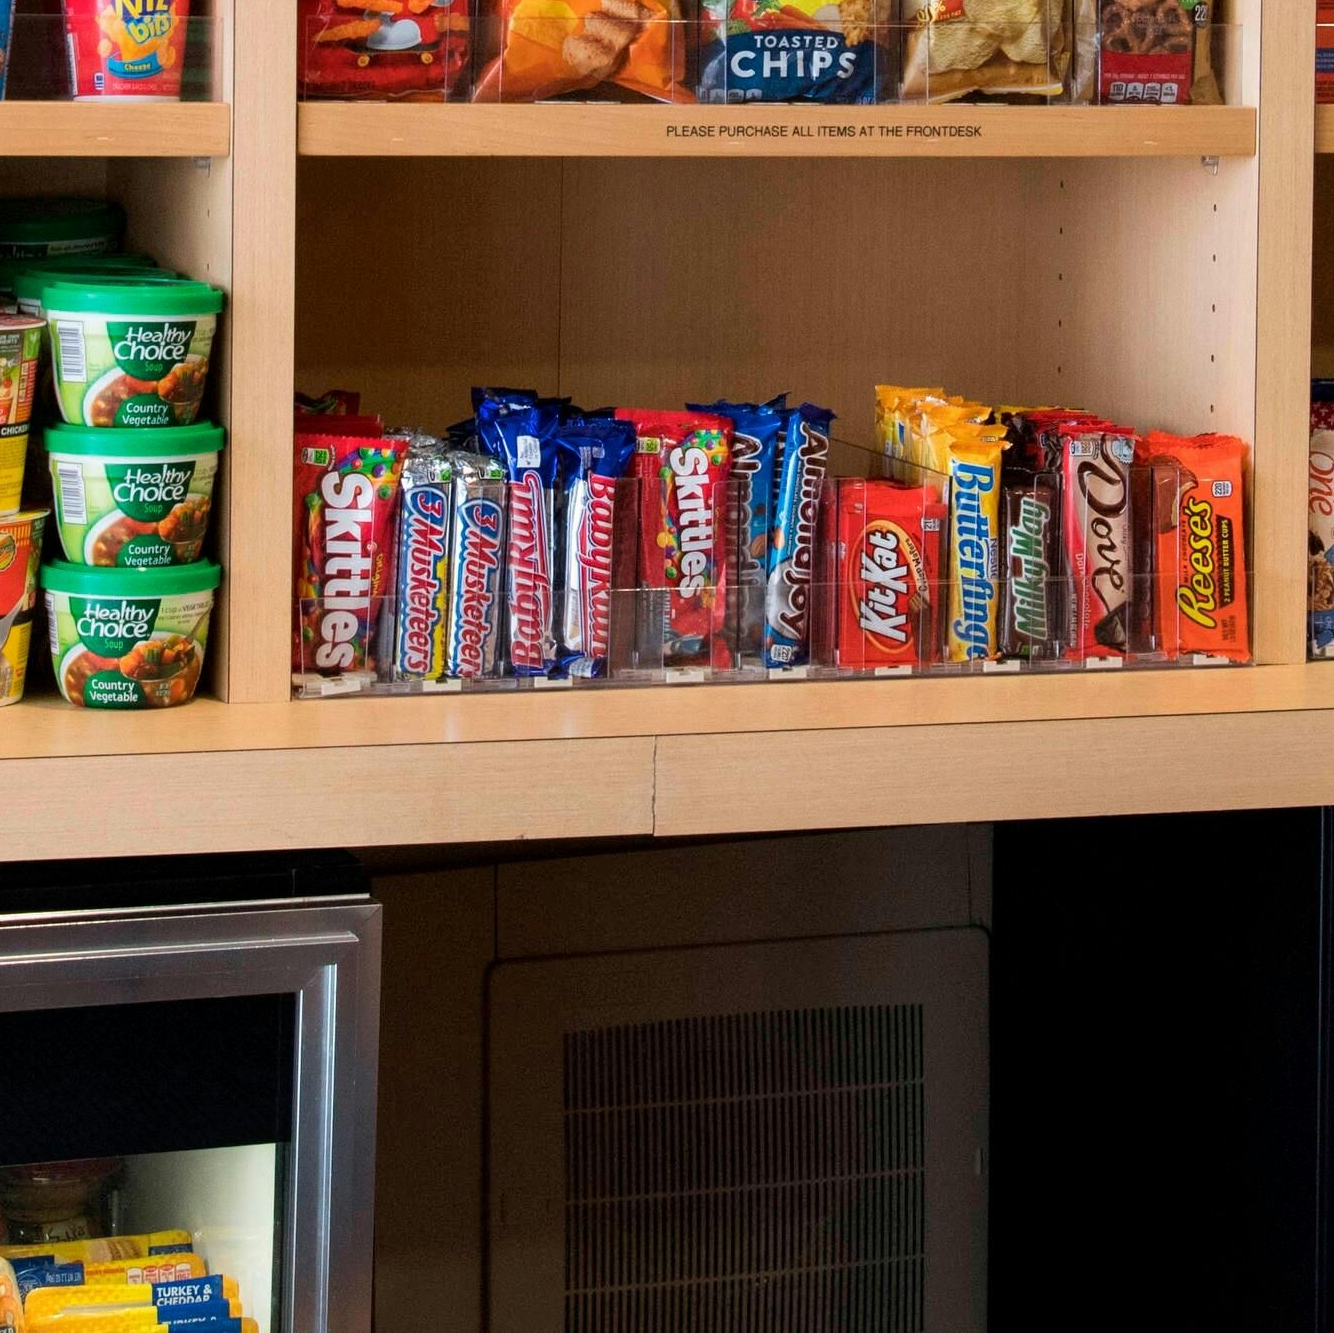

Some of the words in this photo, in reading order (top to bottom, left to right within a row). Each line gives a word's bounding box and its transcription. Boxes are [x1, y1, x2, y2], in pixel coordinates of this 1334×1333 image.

[754, 35, 839, 49] TOASTED
[667, 126, 715, 137] PLEASE
[719, 126, 788, 137] PURCHASE
[792, 126, 814, 137] ALL
[817, 126, 856, 137] ITEMS
[859, 126, 875, 137] AT
[878, 126, 903, 137] THE
[906, 126, 982, 137] FRONTDESK
[125, 323, 192, 344] Healthy
[114, 340, 185, 361] Choice
[144, 362, 163, 373] Soup
[126, 402, 169, 415] Country
[122, 414, 169, 427] Vegetable
[124, 464, 191, 486] Healthy
[113, 482, 185, 503] Choice
[419, 494, 443, 517] 3
[473, 506, 498, 530] 3
[669, 446, 714, 599] Skittles
[1077, 439, 1128, 614] Dove
[1221, 519, 1229, 538] CUPS
[124, 554, 172, 567] Vegetable
[128, 544, 170, 557] Country
[317, 471, 373, 669] Skittles
[1176, 496, 1217, 629] Reese's
[1223, 566, 1231, 597] PEANUT
[405, 519, 445, 673] Musketeers
[76, 617, 149, 638] Choice
[156, 1285, 199, 1297] TURKEY
